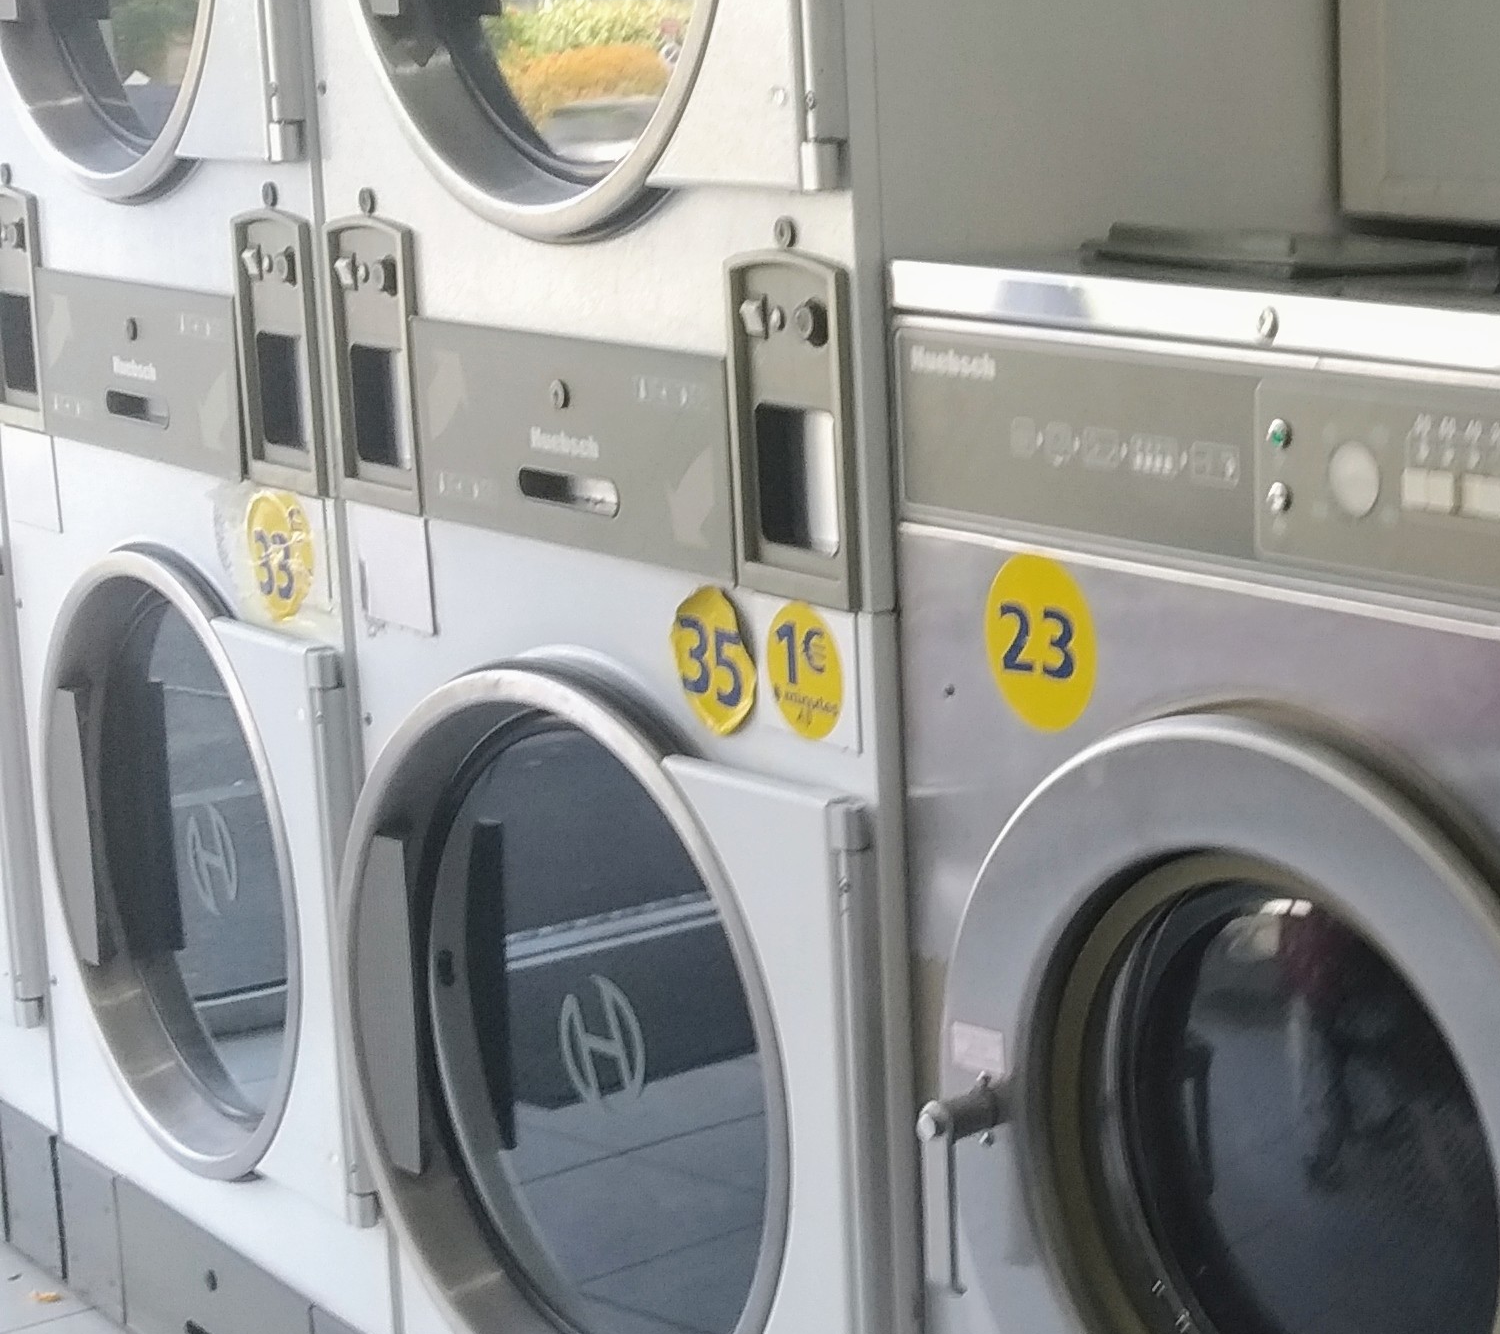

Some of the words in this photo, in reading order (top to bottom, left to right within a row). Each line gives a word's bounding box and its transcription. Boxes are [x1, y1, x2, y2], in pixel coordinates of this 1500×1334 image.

[254, 527, 295, 601] 33
[678, 616, 743, 709] 35
[776, 620, 826, 685] 1€
[999, 602, 1076, 680] 23
